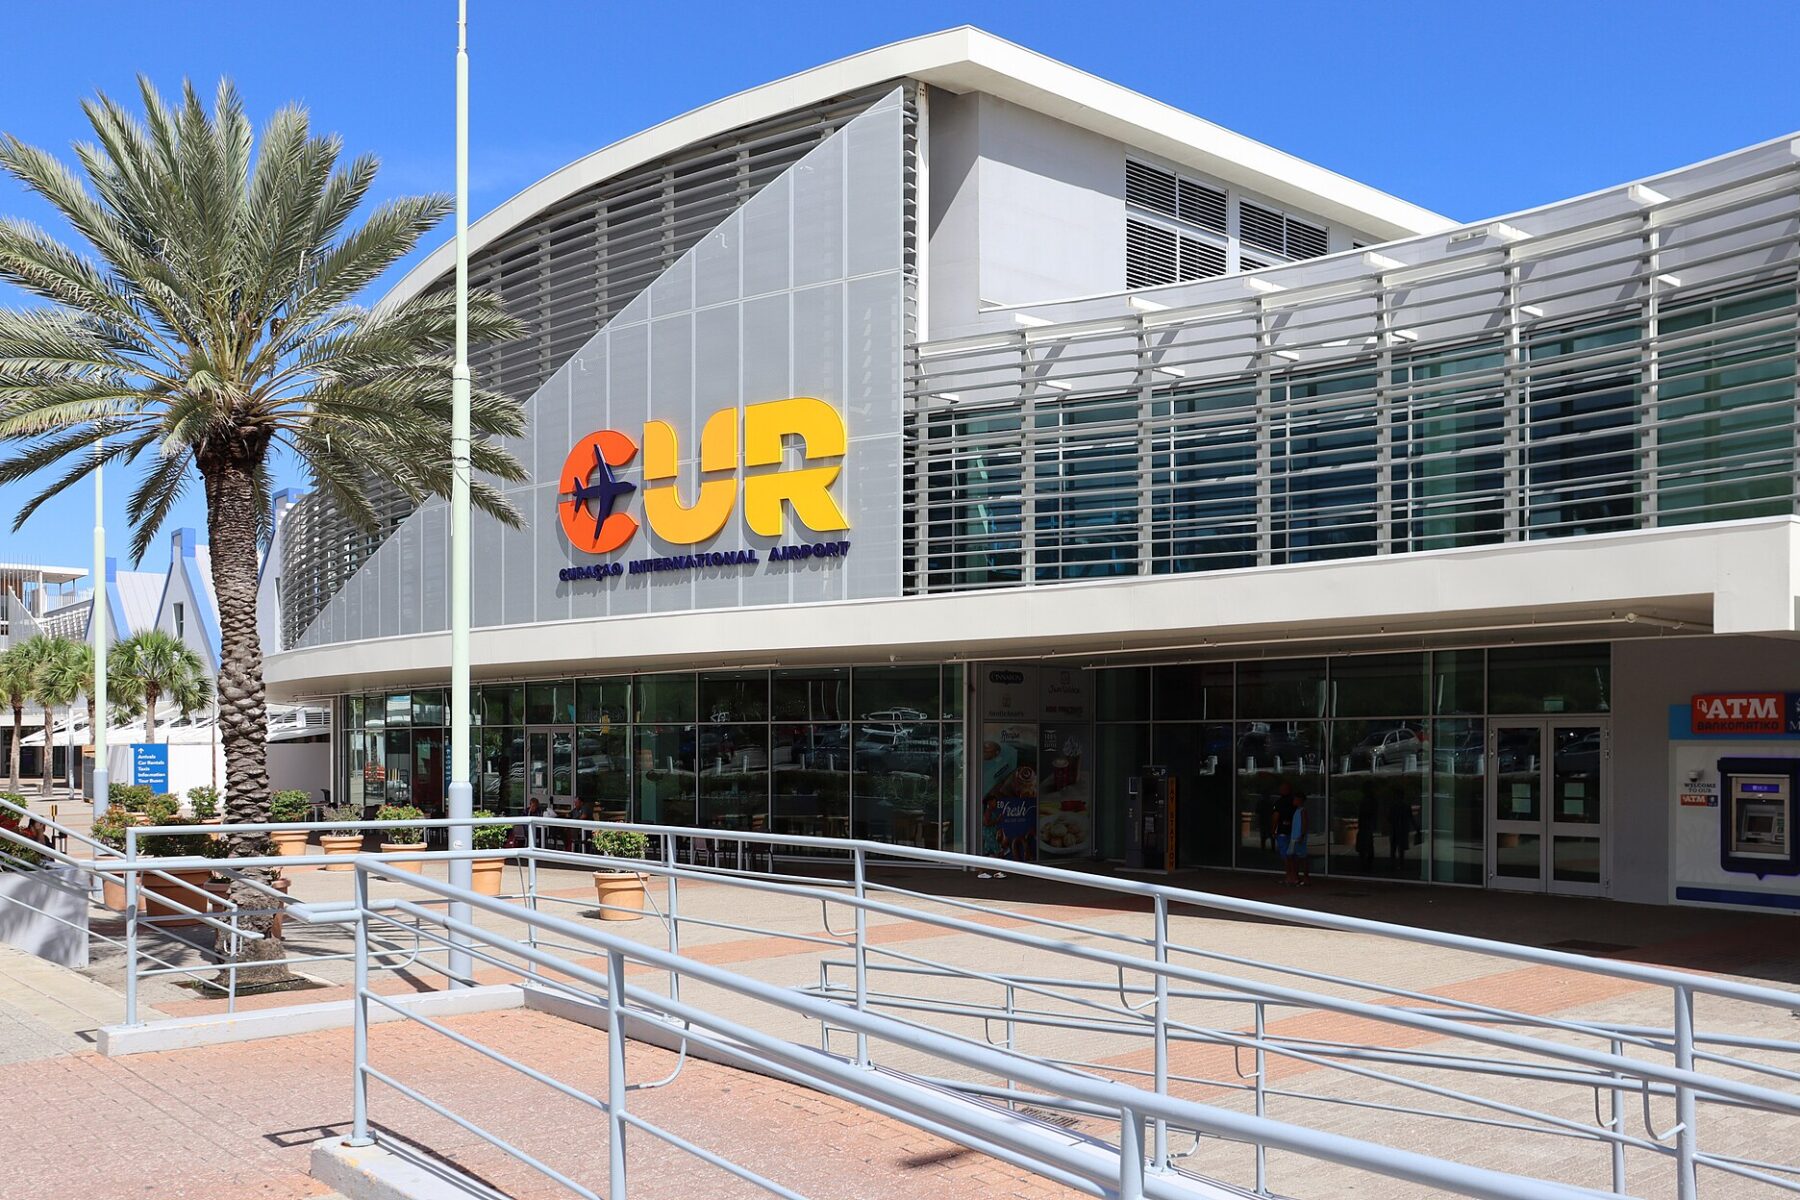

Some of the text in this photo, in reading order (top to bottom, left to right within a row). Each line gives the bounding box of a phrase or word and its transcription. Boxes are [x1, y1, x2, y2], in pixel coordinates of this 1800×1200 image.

[559, 397, 850, 554] CUR
[559, 541, 850, 581] CURAÇAO INTERNATIONAL AIRPORT
[1705, 698, 1779, 719] ATM
[1684, 795, 1706, 803] ATM
